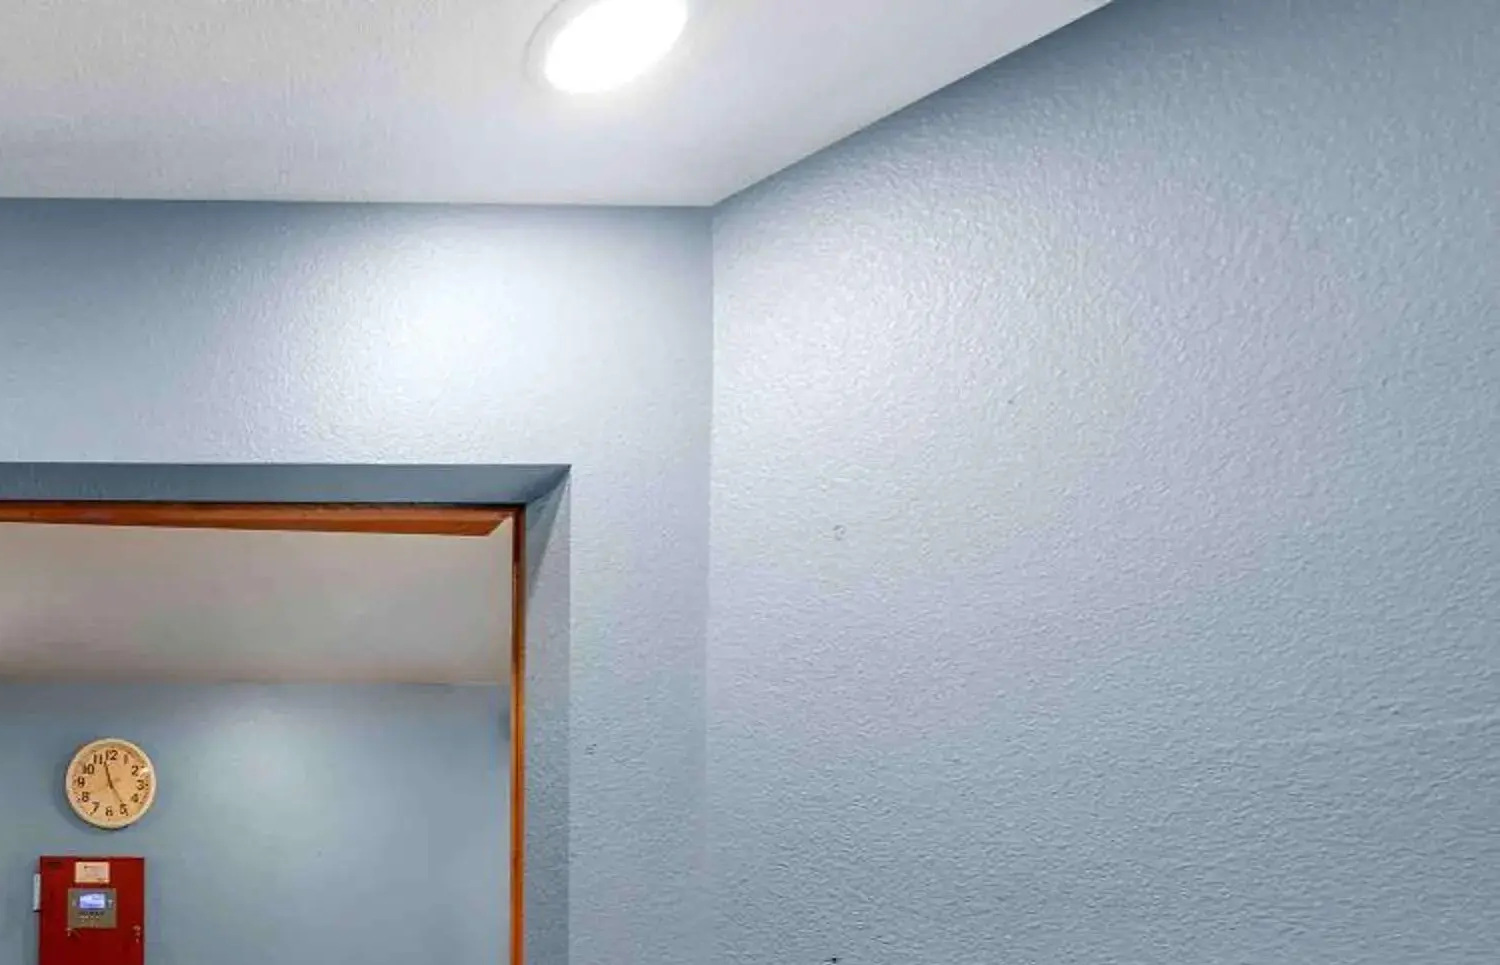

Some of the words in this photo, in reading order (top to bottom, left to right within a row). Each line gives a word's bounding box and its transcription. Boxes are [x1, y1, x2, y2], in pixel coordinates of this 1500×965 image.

[93, 754, 103, 764] 11
[105, 750, 118, 760] 12
[82, 764, 95, 774] 10
[131, 765, 139, 776] 2
[77, 776, 85, 788] 9
[136, 779, 145, 790] 3
[92, 801, 100, 815] 7
